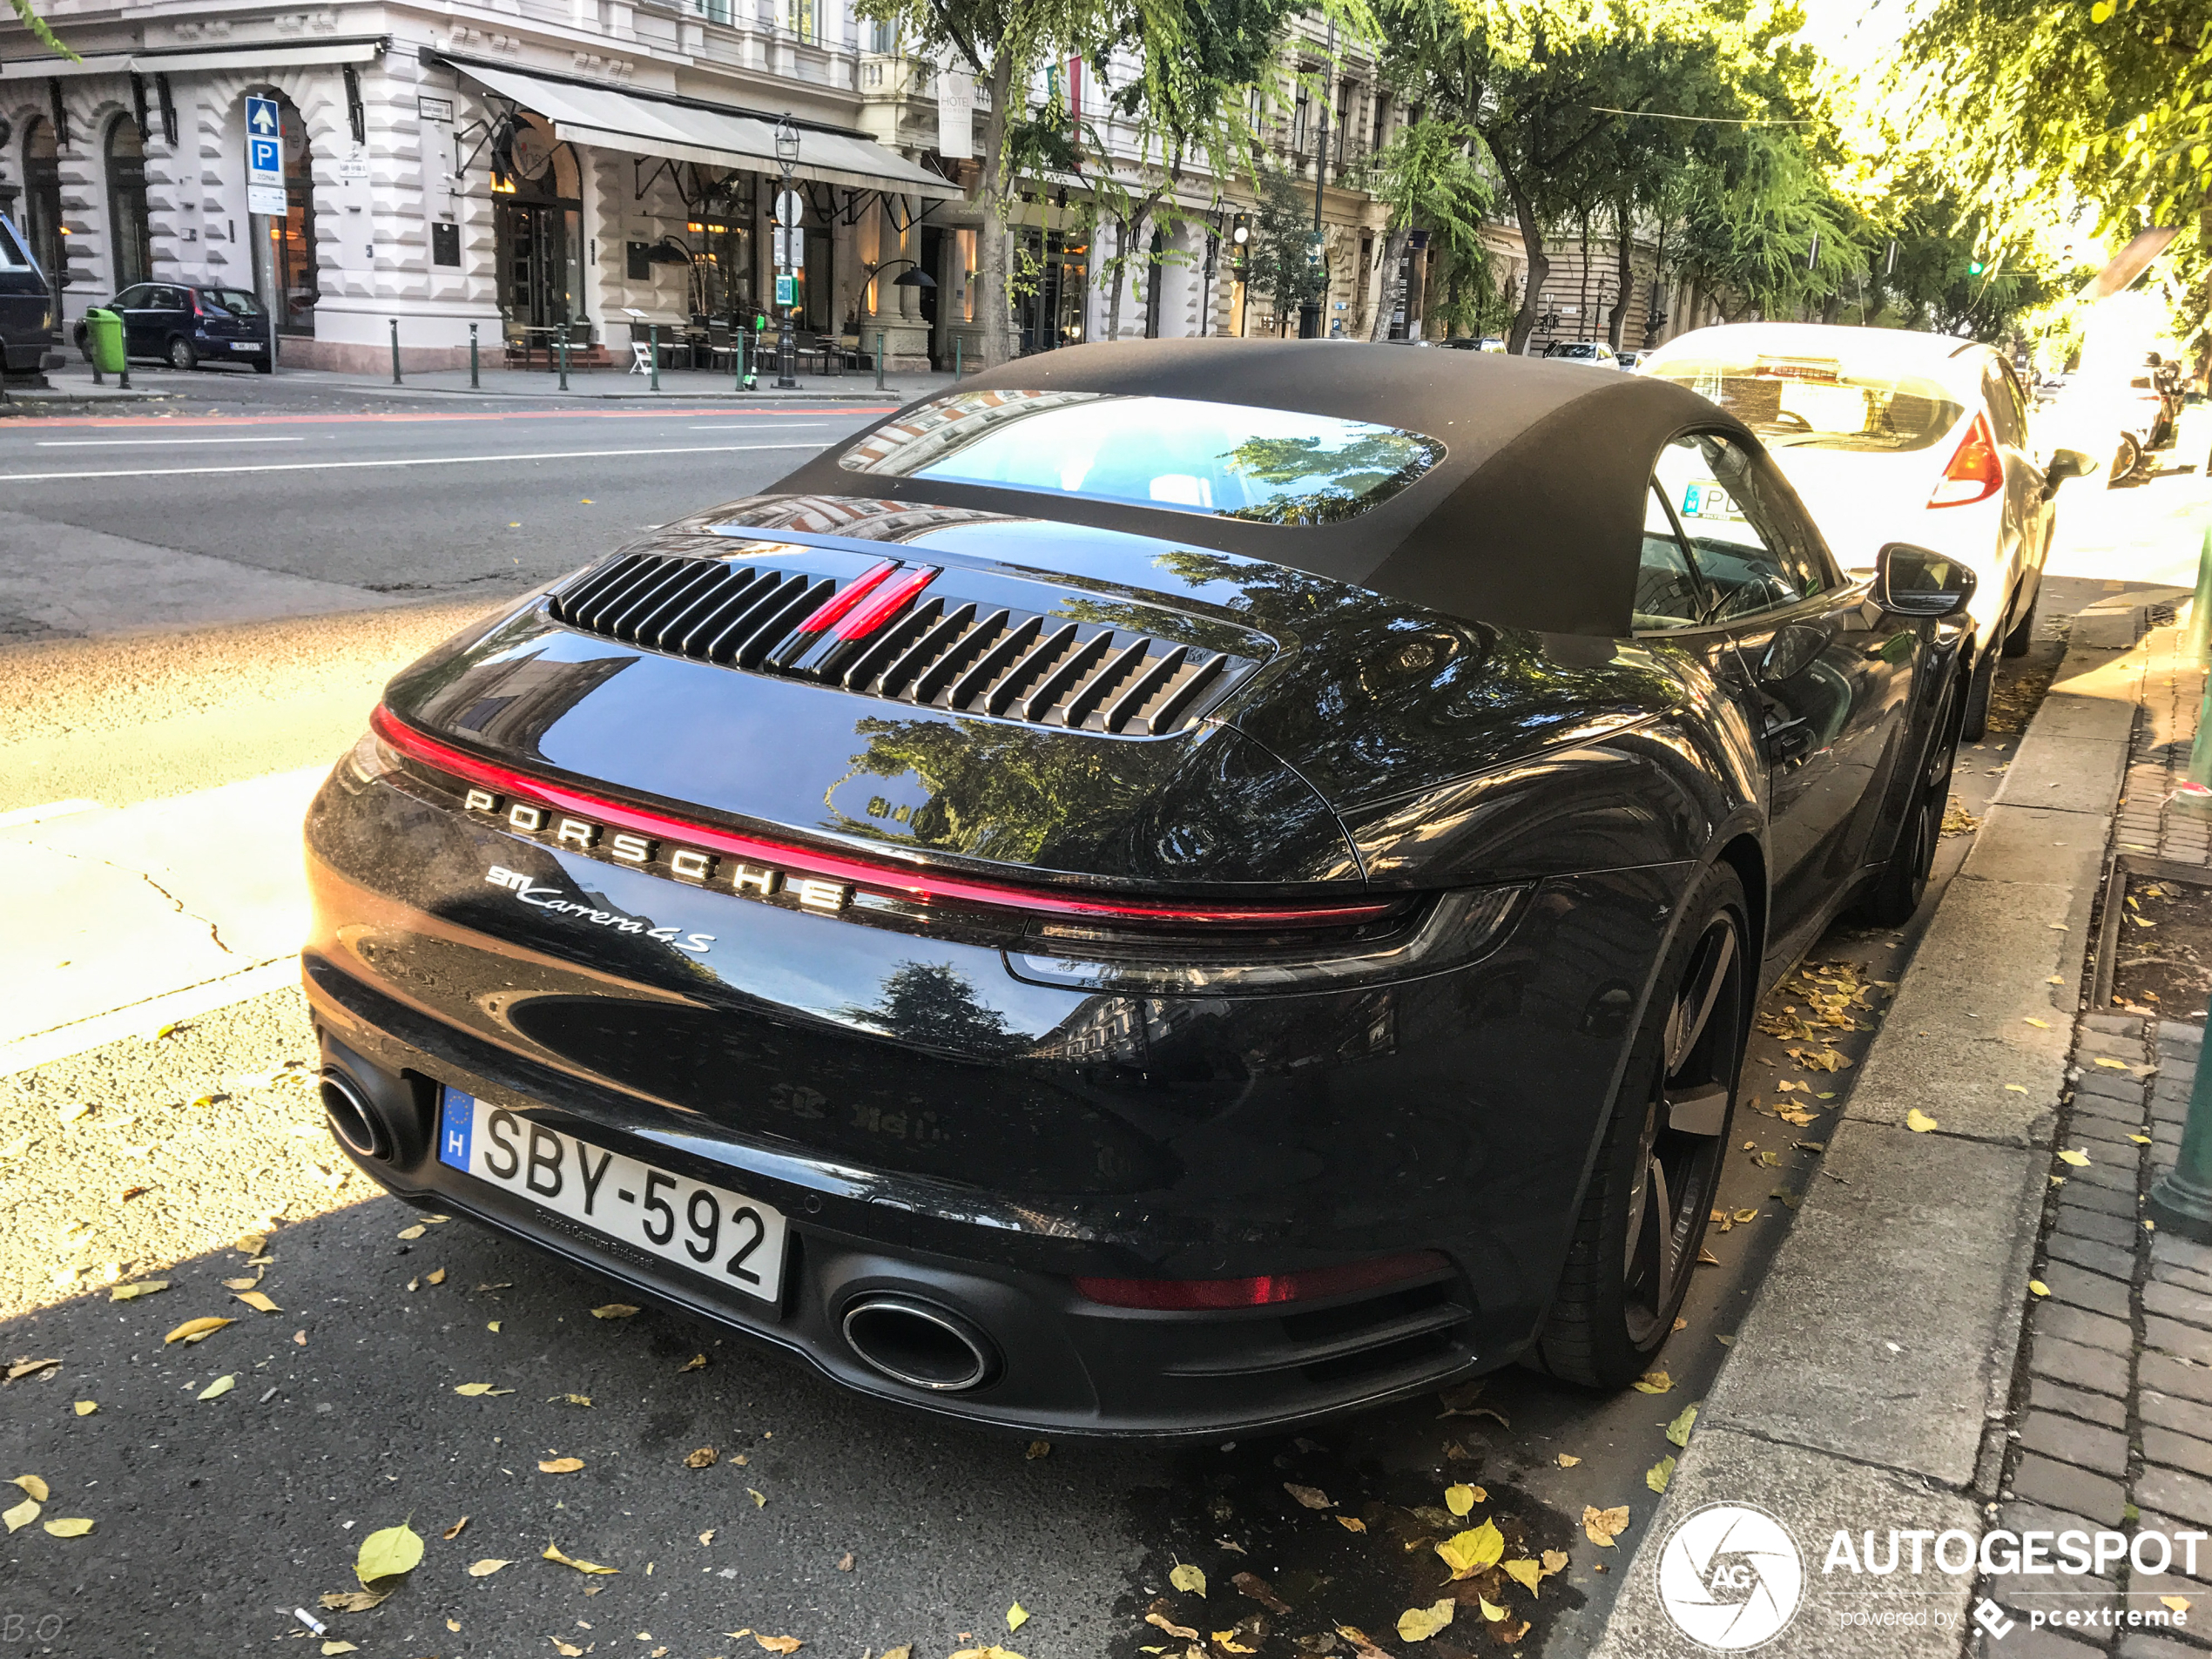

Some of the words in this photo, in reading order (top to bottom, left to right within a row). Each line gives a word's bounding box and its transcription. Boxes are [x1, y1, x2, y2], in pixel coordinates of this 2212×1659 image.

[941, 96, 970, 108] HOTEL
[257, 144, 273, 166] P
[1333, 320, 1339, 328] P
[464, 788, 846, 910] PORSCHE
[485, 865, 533, 891] 911
[516, 887, 644, 934] Carrera
[448, 1130, 463, 1157] H
[483, 1109, 765, 1285] SBY-592
[536, 1209, 570, 1234] Porsche
[571, 1225, 609, 1251] Centrum
[610, 1242, 655, 1271] Budapest
